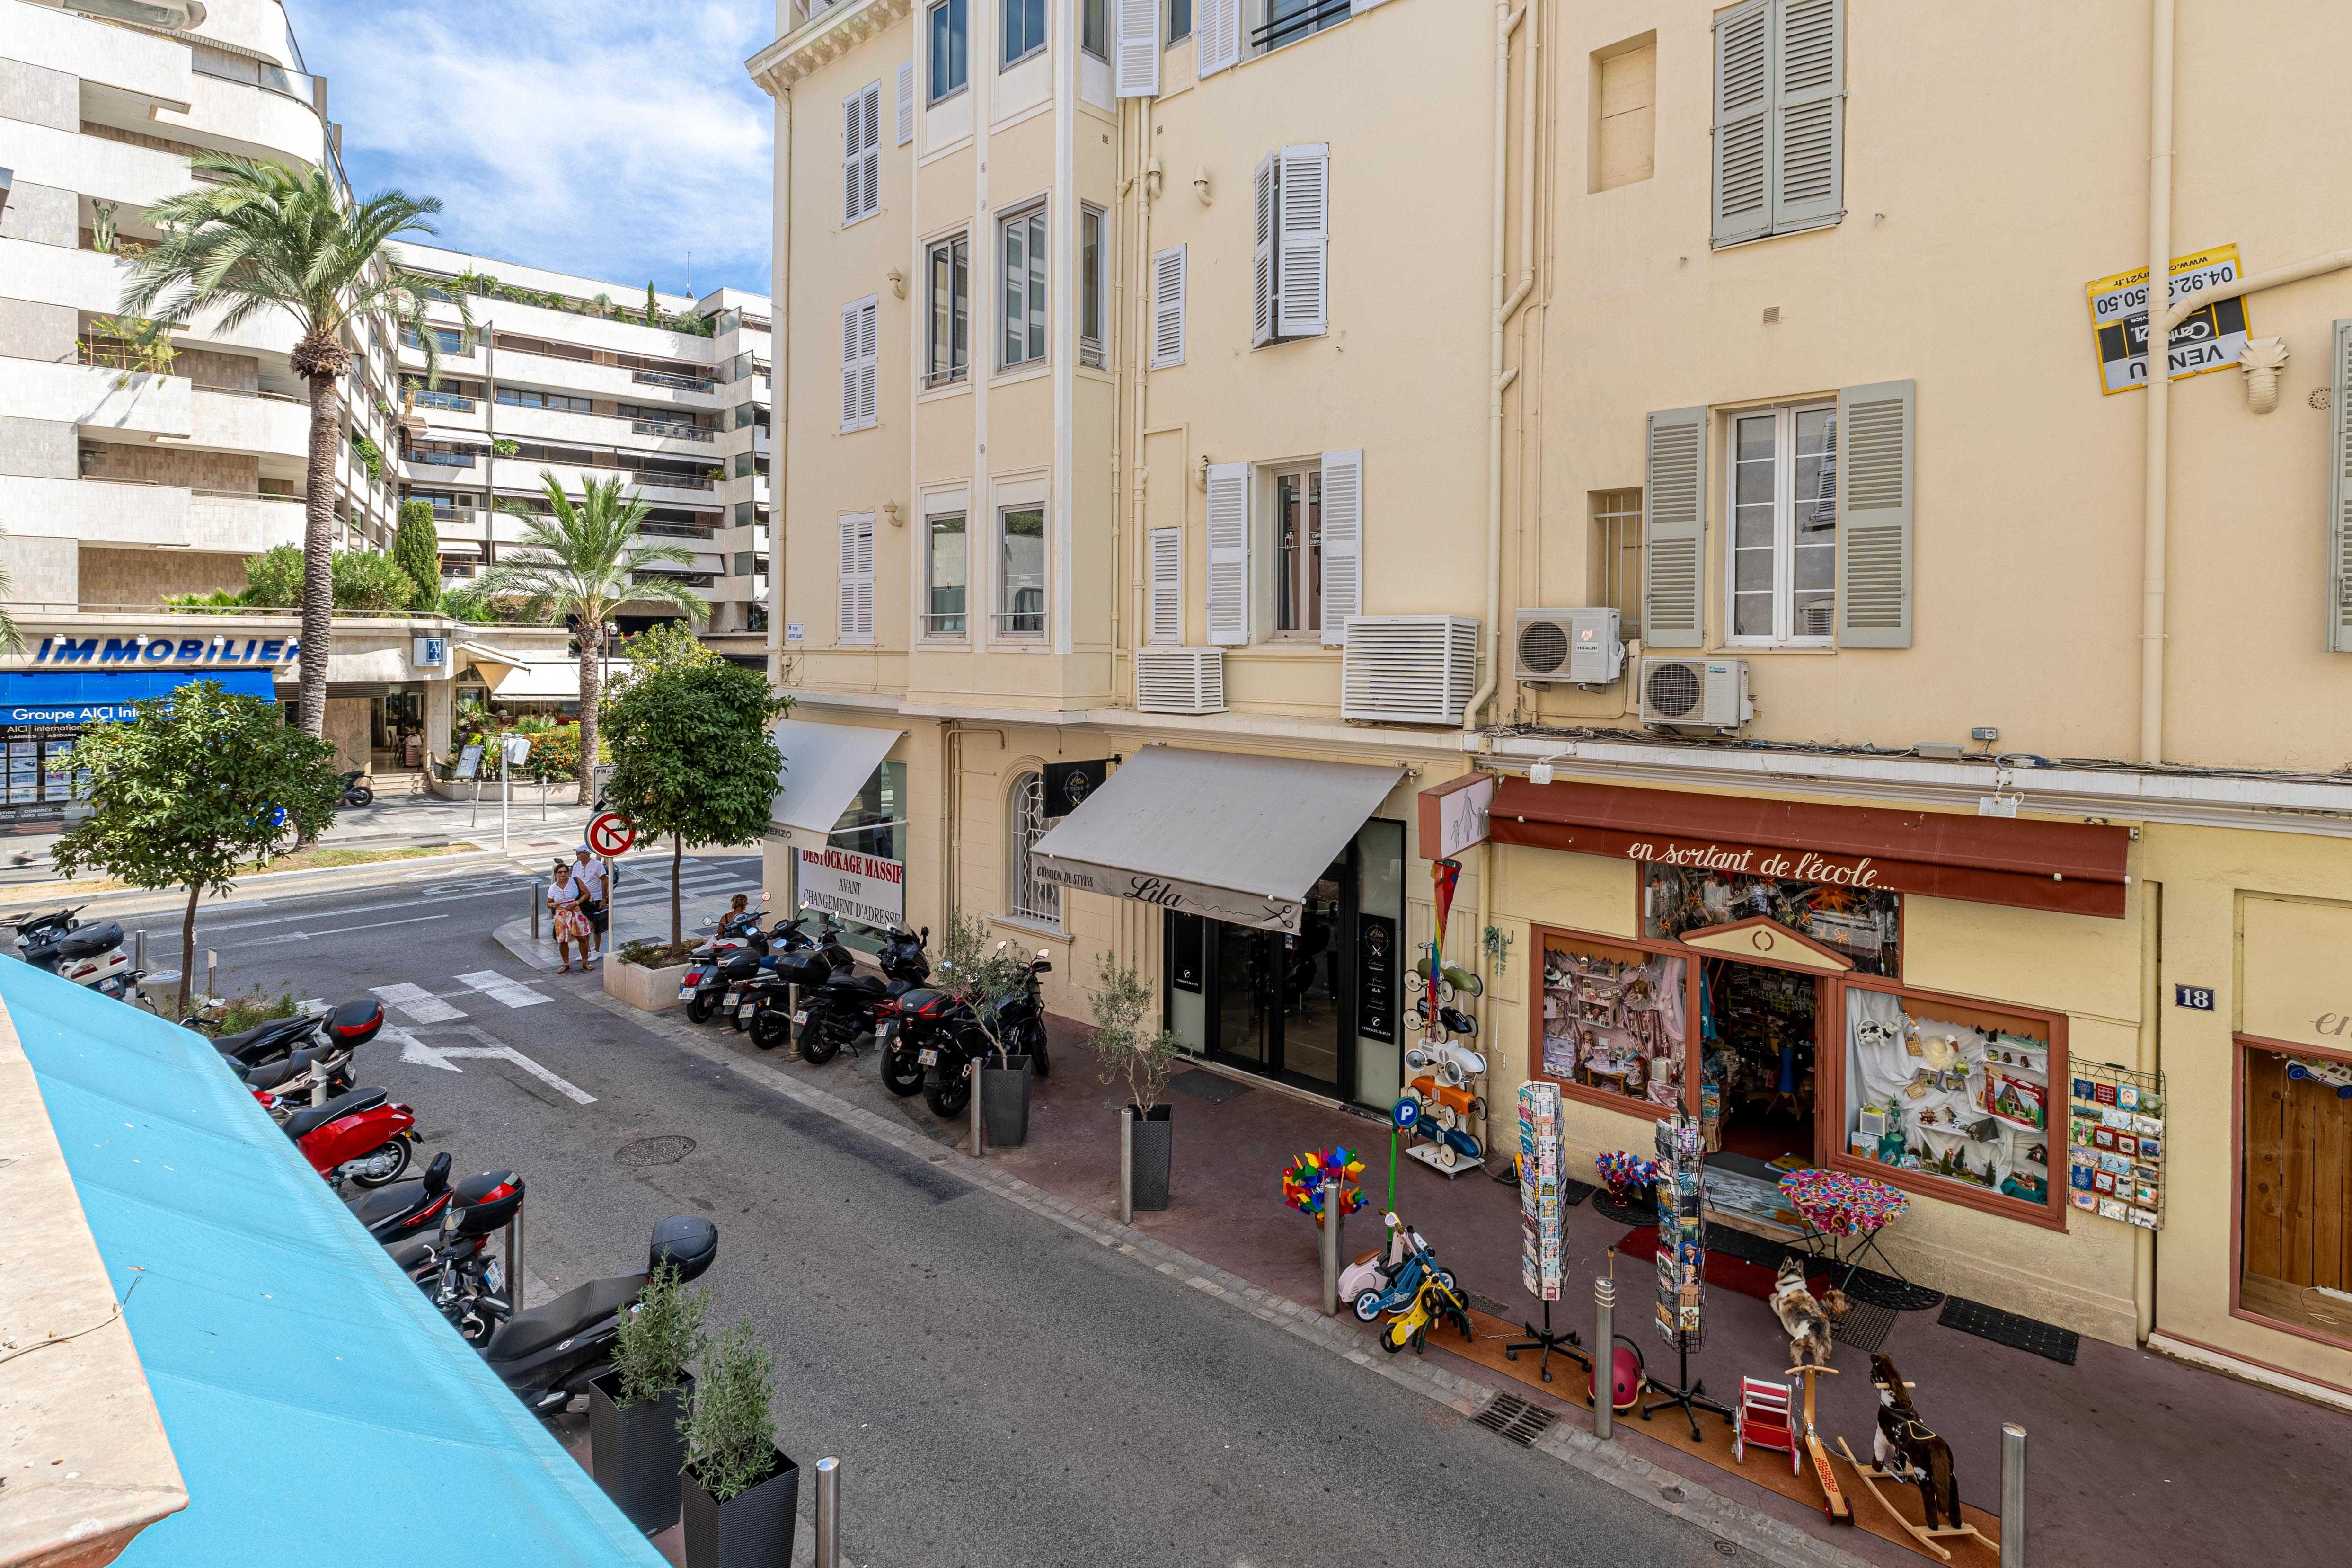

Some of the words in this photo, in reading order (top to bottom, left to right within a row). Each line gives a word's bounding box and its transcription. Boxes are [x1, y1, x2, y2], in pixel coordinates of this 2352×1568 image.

[2129, 345, 2224, 379] VENU
[13, 709, 75, 722] Groupe
[80, 707, 113, 719] AICI
[1627, 842, 1653, 860] en
[1656, 844, 1753, 871] sortant
[1760, 854, 1791, 877] de
[865, 858, 902, 884] MASSIF
[1064, 872, 1072, 883] DE
[1073, 874, 1093, 887] STYLES
[838, 877, 861, 896] AVANT
[1123, 876, 1183, 907] Lila
[804, 888, 854, 916] CHANGEMENT
[855, 902, 900, 926] D'ADRESSE
[2183, 988, 2209, 1008] 18
[1432, 1087, 1440, 1102] 01
[1401, 1106, 1413, 1120] P
[1437, 1130, 1444, 1144] 01
